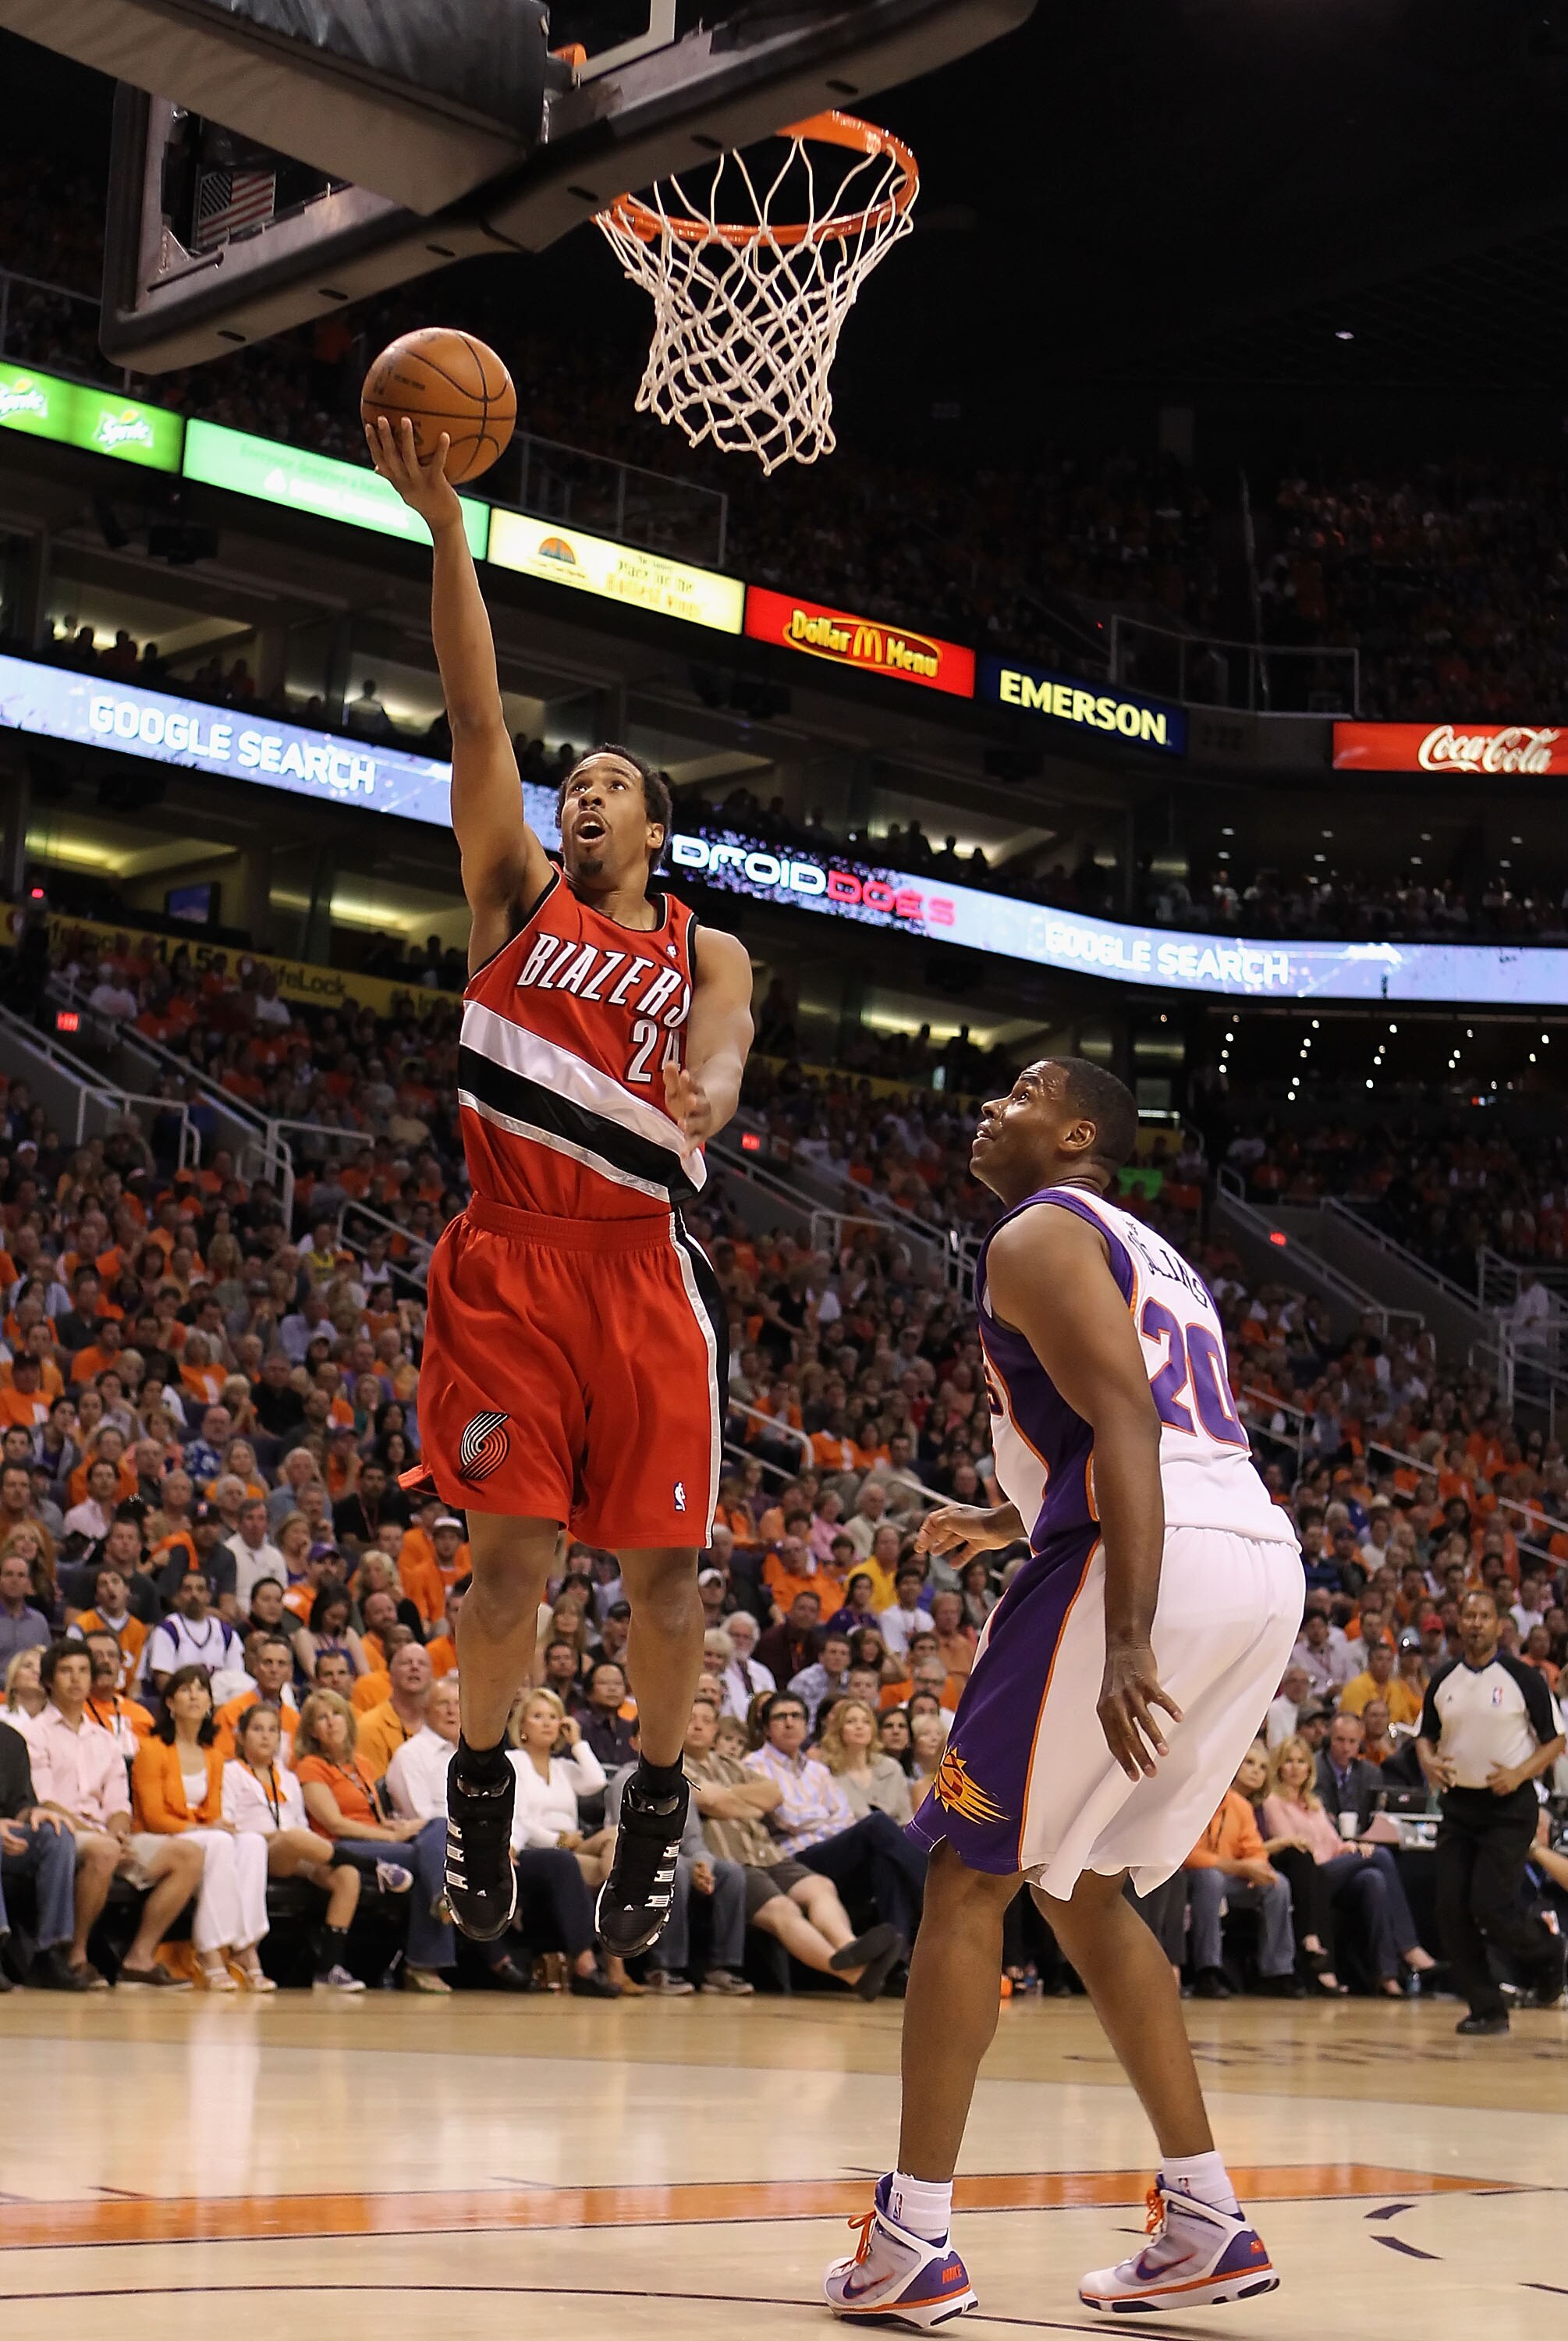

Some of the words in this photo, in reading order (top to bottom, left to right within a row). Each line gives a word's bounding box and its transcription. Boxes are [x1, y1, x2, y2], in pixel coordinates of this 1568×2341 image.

[791, 609, 853, 652] Dollar
[886, 636, 938, 678] Menu
[89, 695, 233, 762] GOOGLE
[237, 730, 377, 795] SEARCH
[999, 669, 1168, 745] EMERSON
[672, 833, 827, 895] DROID
[827, 869, 956, 926] DOES
[1045, 921, 1151, 972] GOOGLE
[1157, 943, 1290, 986] SEARCH
[1140, 1297, 1251, 1451] 20
[942, 2264, 963, 2285] NIKE
